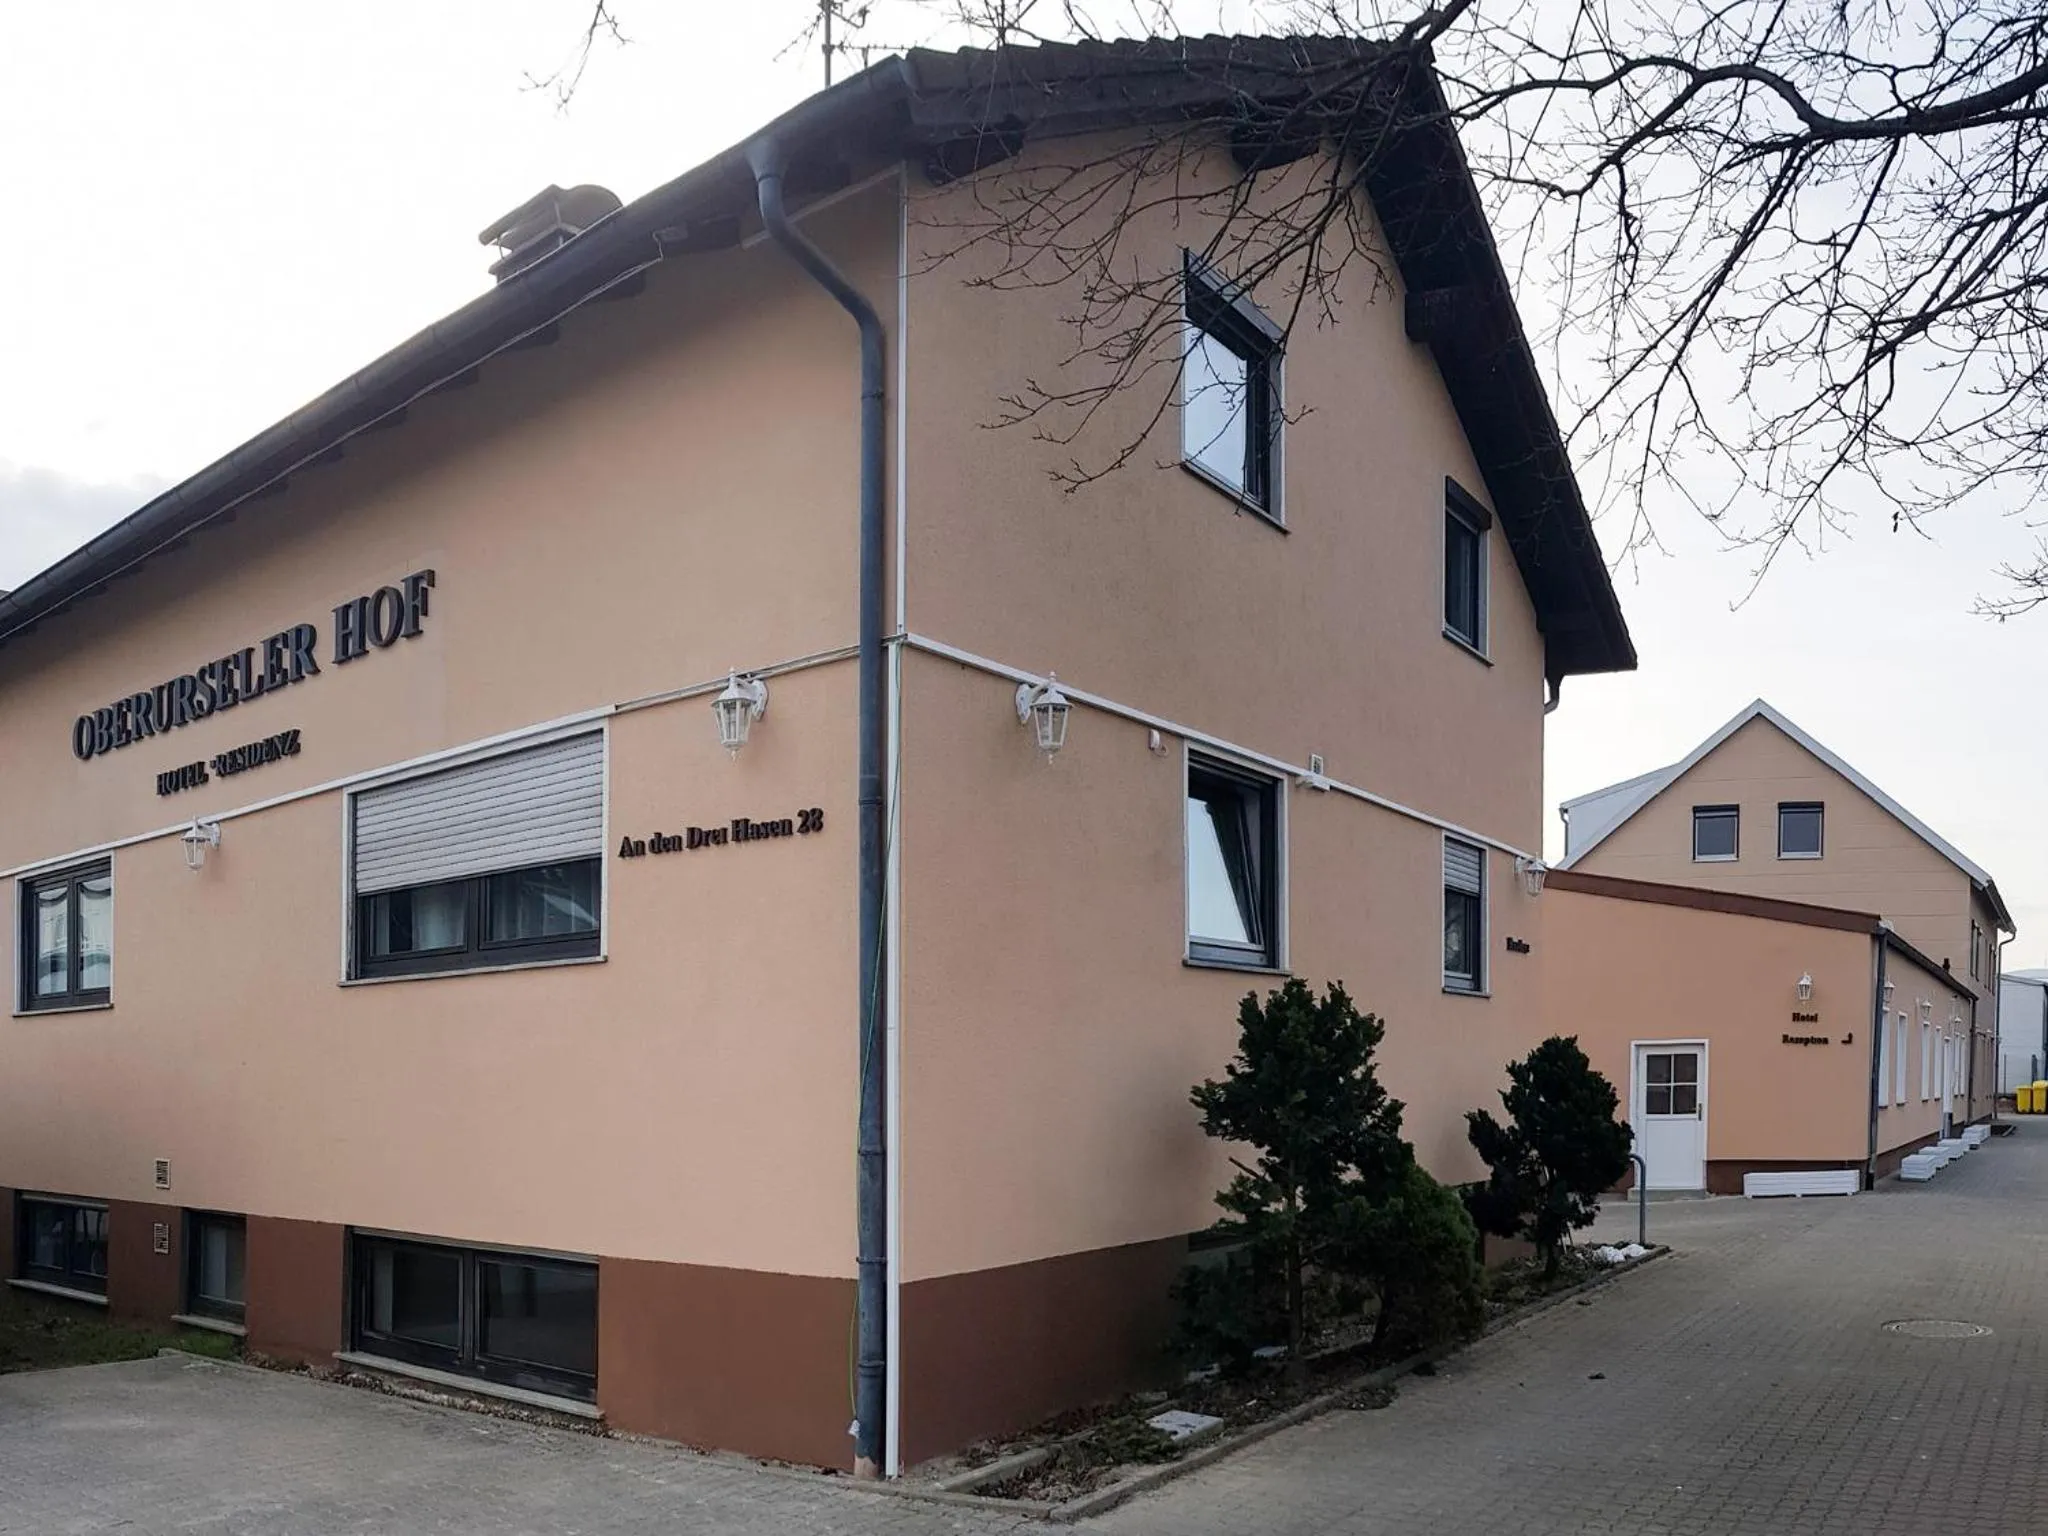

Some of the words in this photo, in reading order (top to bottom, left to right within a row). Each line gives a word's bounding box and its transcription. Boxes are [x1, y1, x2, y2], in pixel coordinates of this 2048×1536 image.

[72, 623, 320, 761] OBERURSELER
[332, 569, 435, 665] HOF
[156, 761, 209, 796] HOTEL
[618, 836, 646, 859] An
[648, 832, 682, 855] den
[686, 827, 728, 850] Drei
[731, 818, 793, 843] Hasen
[797, 808, 824, 834] 28
[1792, 1012, 1818, 1022] Hotel
